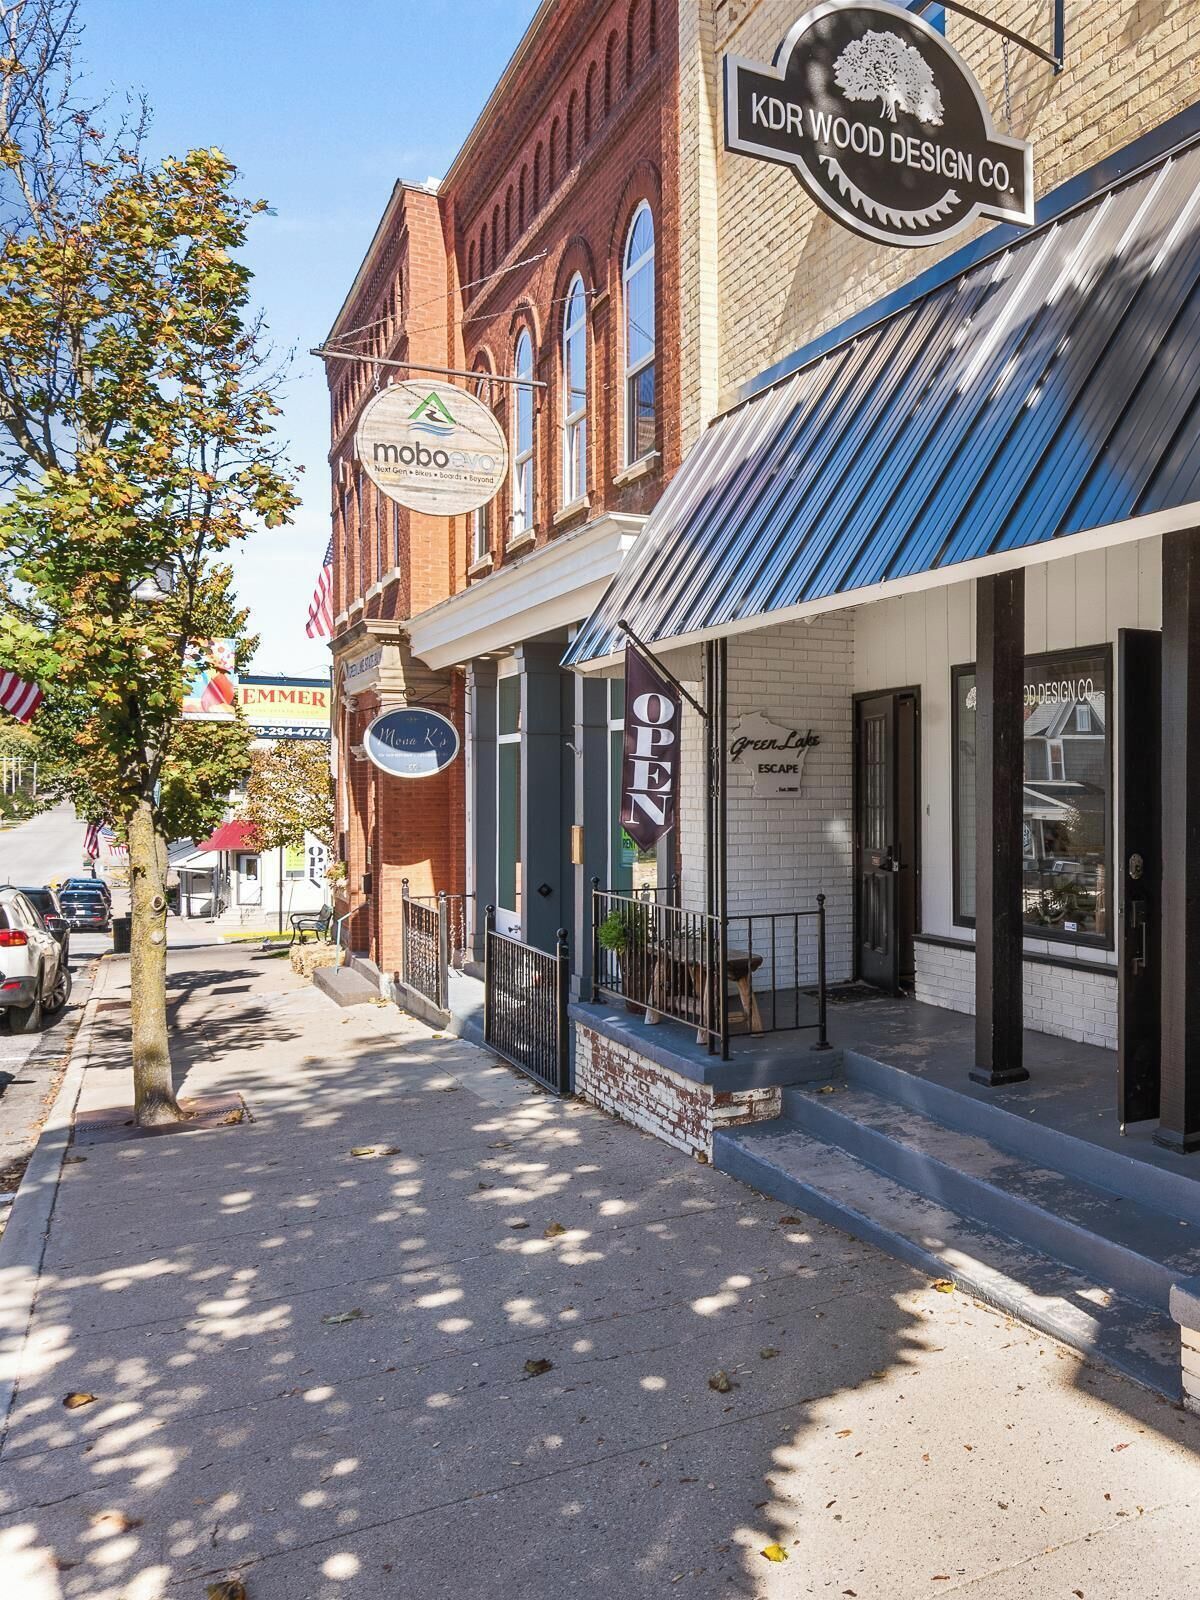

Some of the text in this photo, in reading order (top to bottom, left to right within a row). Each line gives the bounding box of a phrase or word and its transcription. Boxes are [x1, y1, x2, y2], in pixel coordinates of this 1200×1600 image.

[752, 92, 1015, 194] KDR WOOD DESIGN CO.
[374, 465, 391, 473] Next
[392, 467, 408, 476] Gen
[415, 469, 433, 478] Bikes
[439, 471, 463, 481] Boards
[243, 688, 327, 708] EMMER
[1039, 679, 1075, 705] DESIGN
[377, 728, 447, 748] Mona K's
[730, 729, 820, 761] Green Lake
[623, 692, 675, 826] OPEN
[758, 764, 799, 774] ESCAPE
